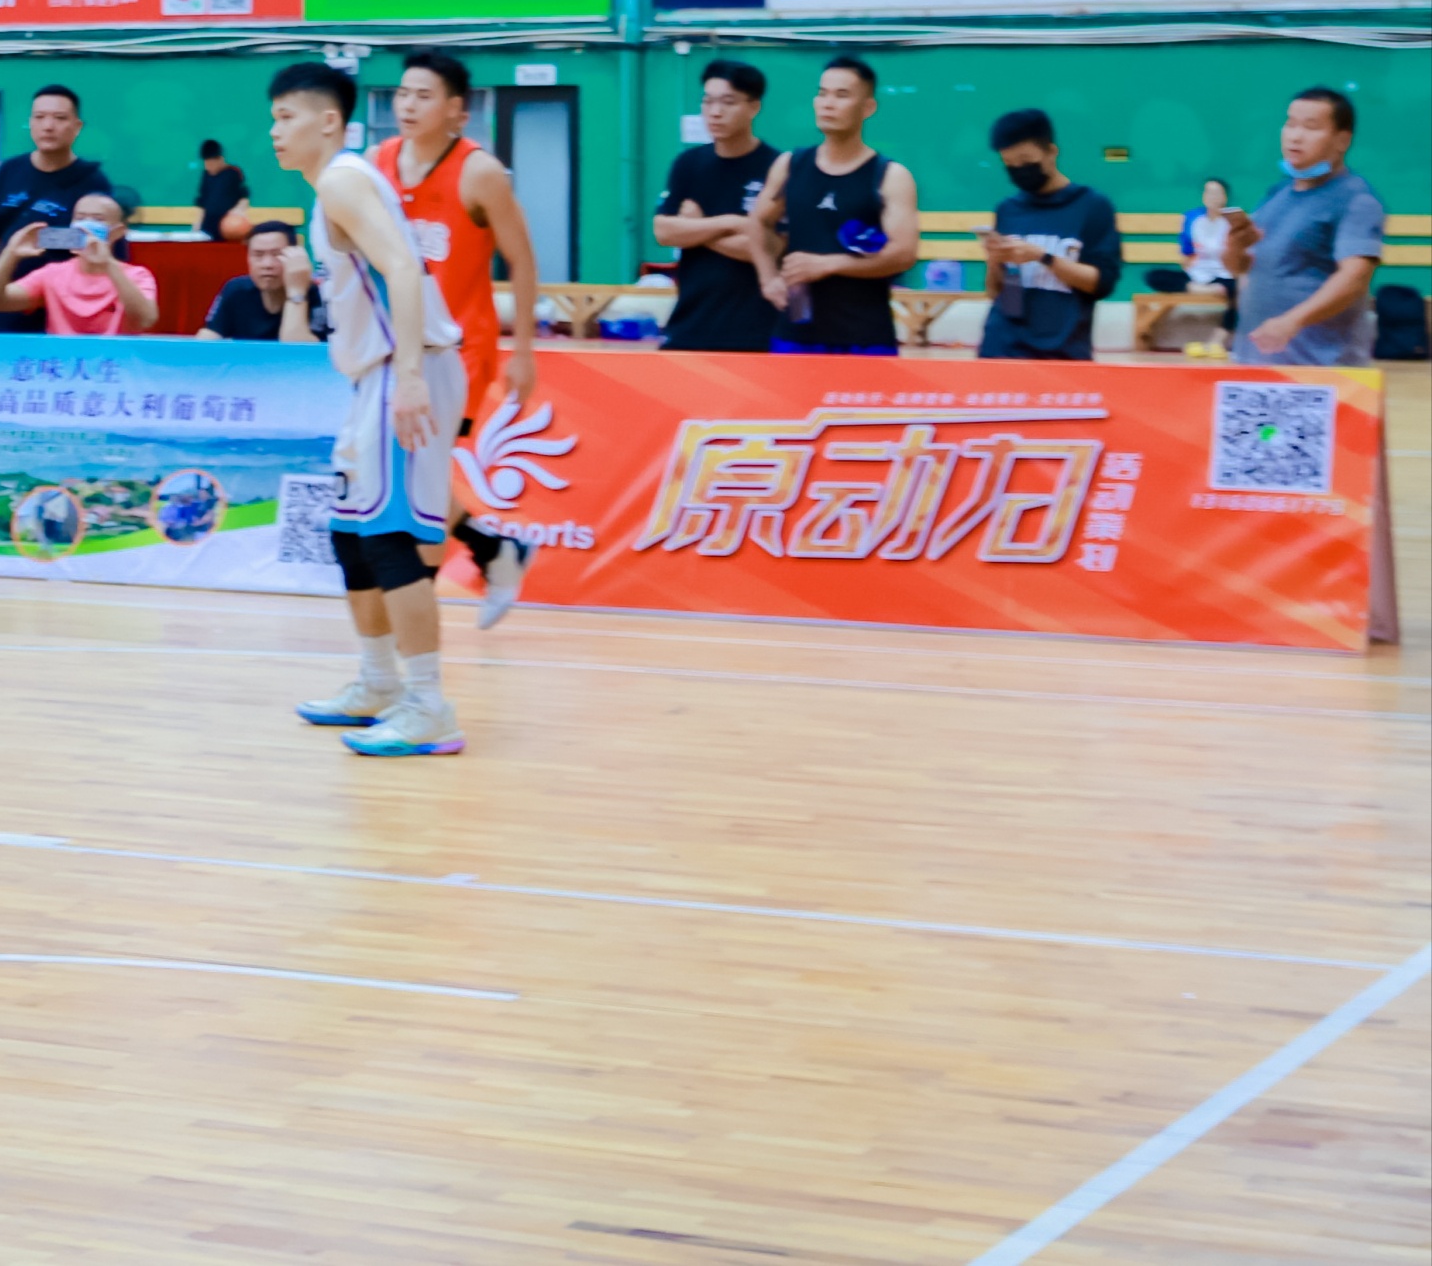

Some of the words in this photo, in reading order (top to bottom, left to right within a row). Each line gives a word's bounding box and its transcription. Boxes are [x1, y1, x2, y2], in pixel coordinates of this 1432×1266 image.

[10, 355, 121, 384] 意味人生
[633, 407, 1109, 565] 原动力
[1075, 451, 1143, 572] 活动策划
